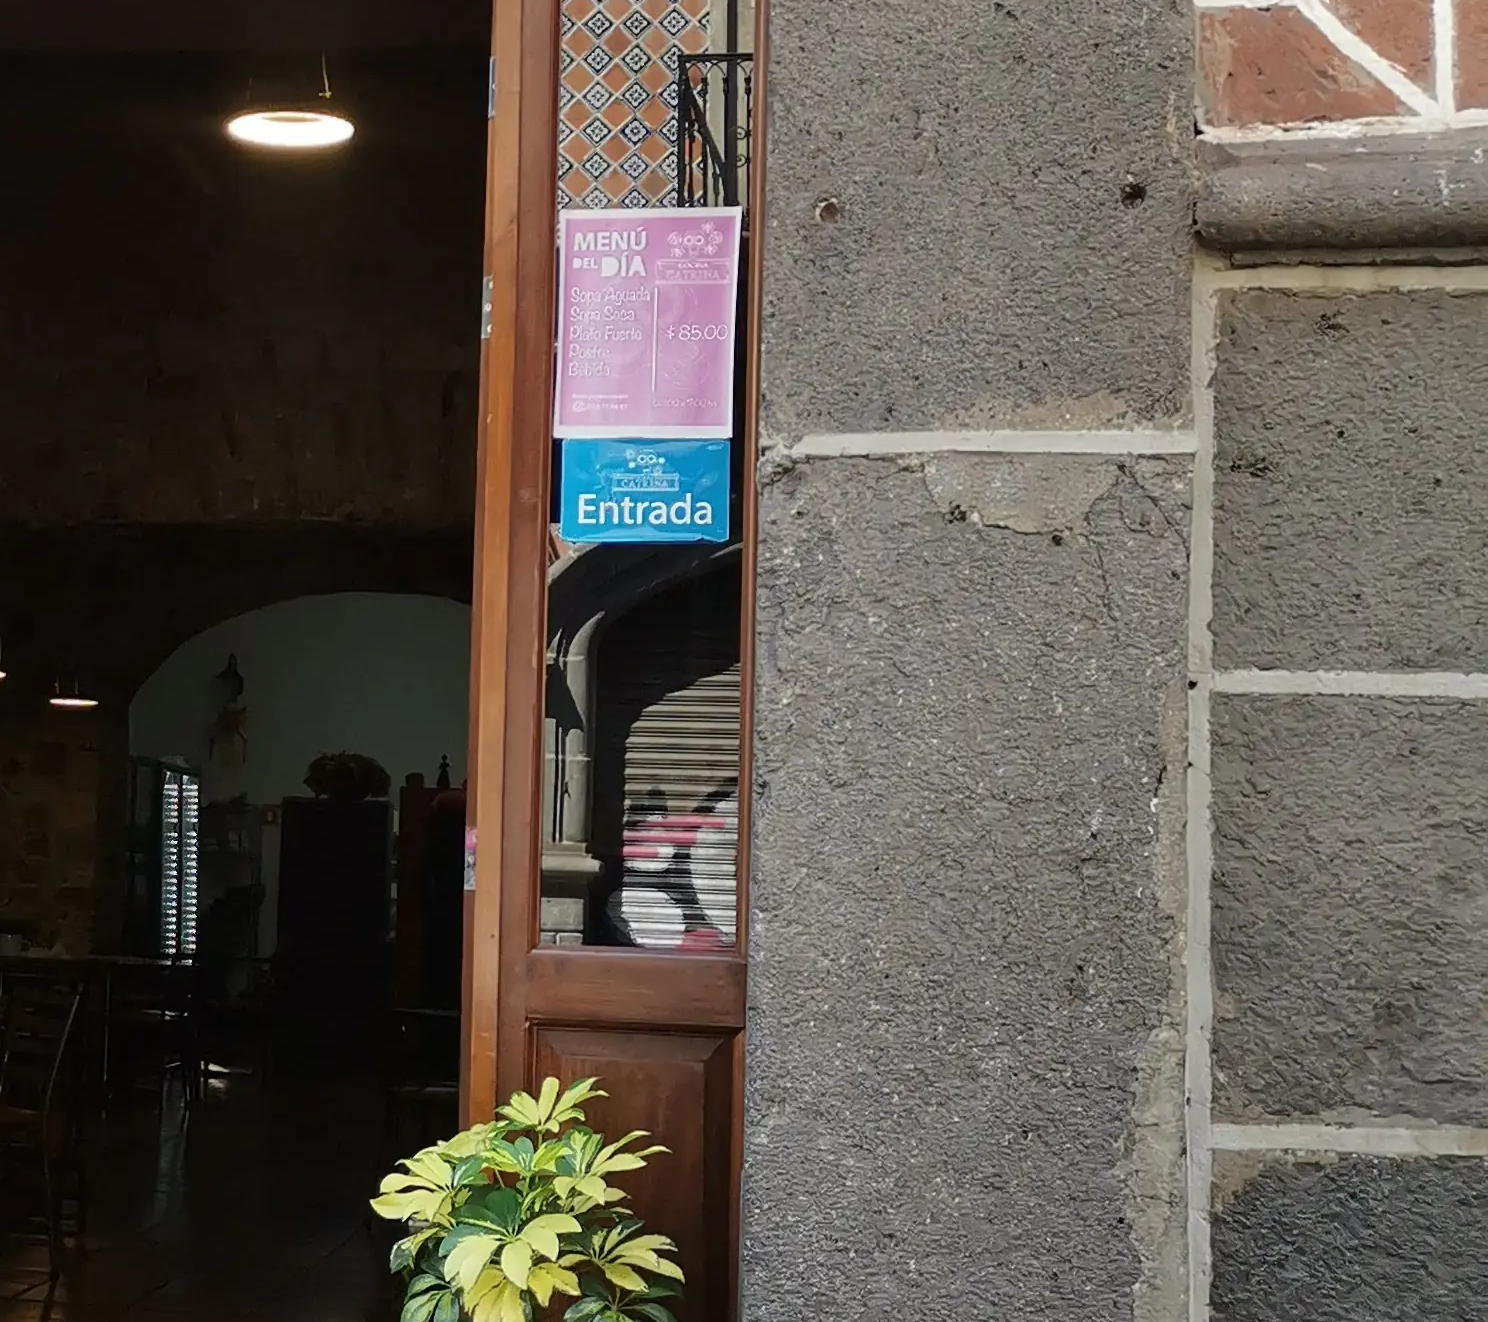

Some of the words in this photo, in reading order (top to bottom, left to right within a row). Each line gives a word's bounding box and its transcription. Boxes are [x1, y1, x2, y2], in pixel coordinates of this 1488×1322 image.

[573, 227, 647, 251] MENÚ
[573, 258, 598, 269] DEL
[601, 251, 647, 277] DÍA
[571, 287, 601, 306] Sopa
[604, 286, 651, 306] Aguada
[570, 325, 601, 341] Plato
[679, 324, 728, 341] 85.00
[578, 492, 712, 525] Entrada
